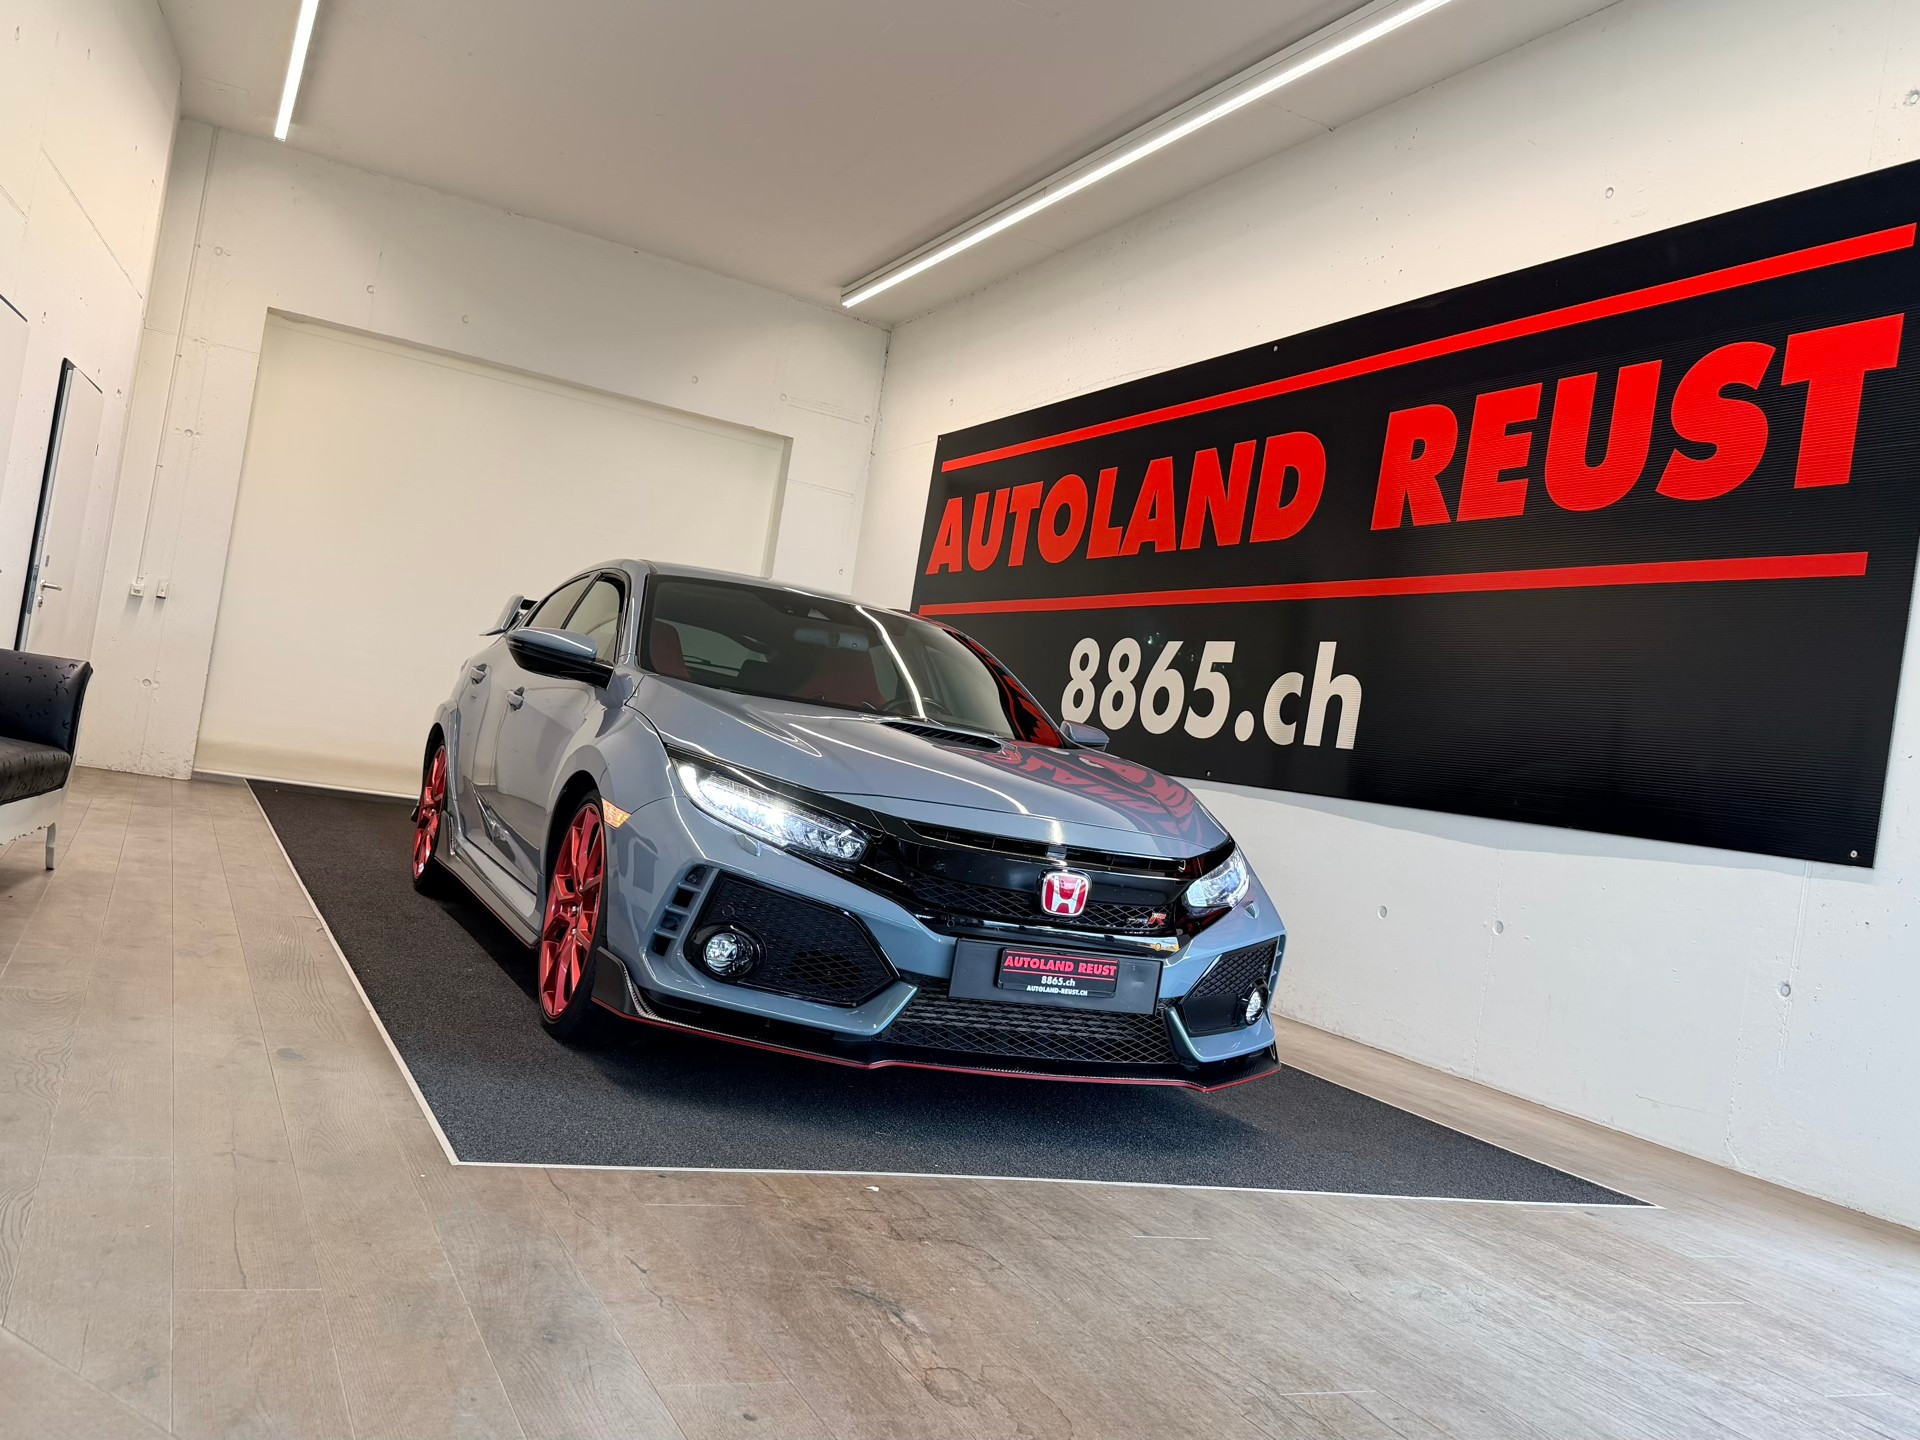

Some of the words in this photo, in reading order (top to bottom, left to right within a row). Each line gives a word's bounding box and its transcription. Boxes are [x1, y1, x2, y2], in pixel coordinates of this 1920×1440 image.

[926, 432, 1327, 575] AUTOLAND
[1371, 313, 1905, 531] REUST
[1060, 637, 1362, 750] 8865.ch
[1004, 956, 1074, 971] AUTOLAND
[1078, 963, 1117, 976] REUST
[1026, 985, 1088, 996] AUTOLAND-REUST.CH
[1041, 975, 1075, 986] 8865.ch
